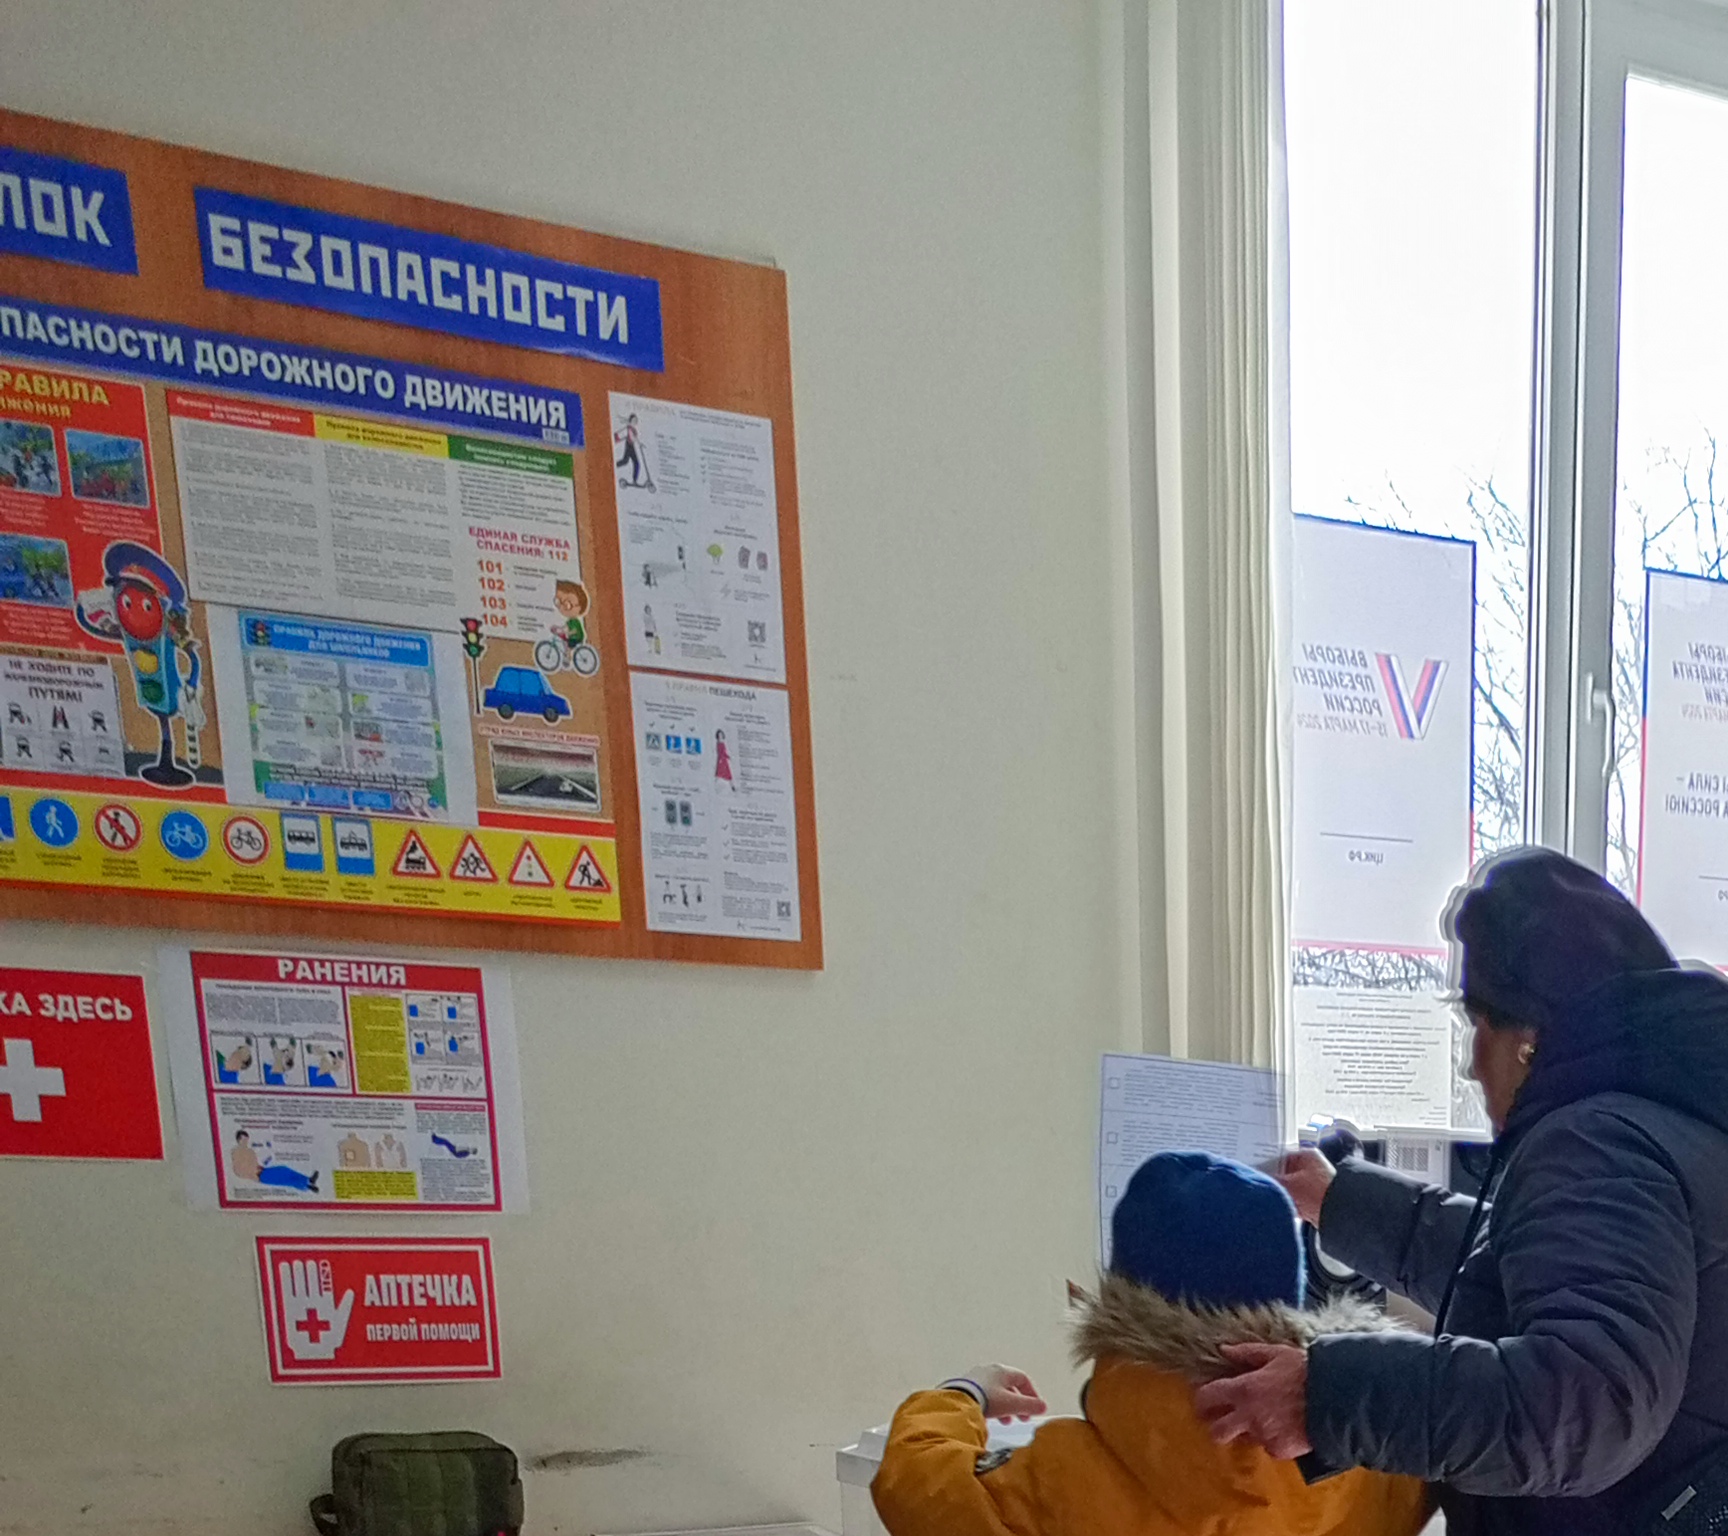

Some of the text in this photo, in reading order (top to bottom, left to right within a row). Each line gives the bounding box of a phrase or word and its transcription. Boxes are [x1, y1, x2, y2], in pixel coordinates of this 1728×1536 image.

[208, 213, 628, 344] БЕЗОПАСНОСТИ
[0, 306, 568, 430] ПАСНОСТИ ДОРОЖНОГО ДВИЖЕНИЯ
[469, 526, 571, 549] ЕДИНАЯ СЛУЖБА
[478, 560, 503, 575] 101
[549, 550, 568, 561] 112
[479, 577, 505, 592] 102
[480, 596, 507, 610] 103
[482, 613, 508, 628] 104
[277, 959, 407, 986] РАНЕНИЯ
[38, 993, 133, 1023] ЗДЕСЬ
[364, 1274, 477, 1307] АПТЕЧКА
[366, 1317, 481, 1343] ПЕРВОЙ ПОМОЩИ
